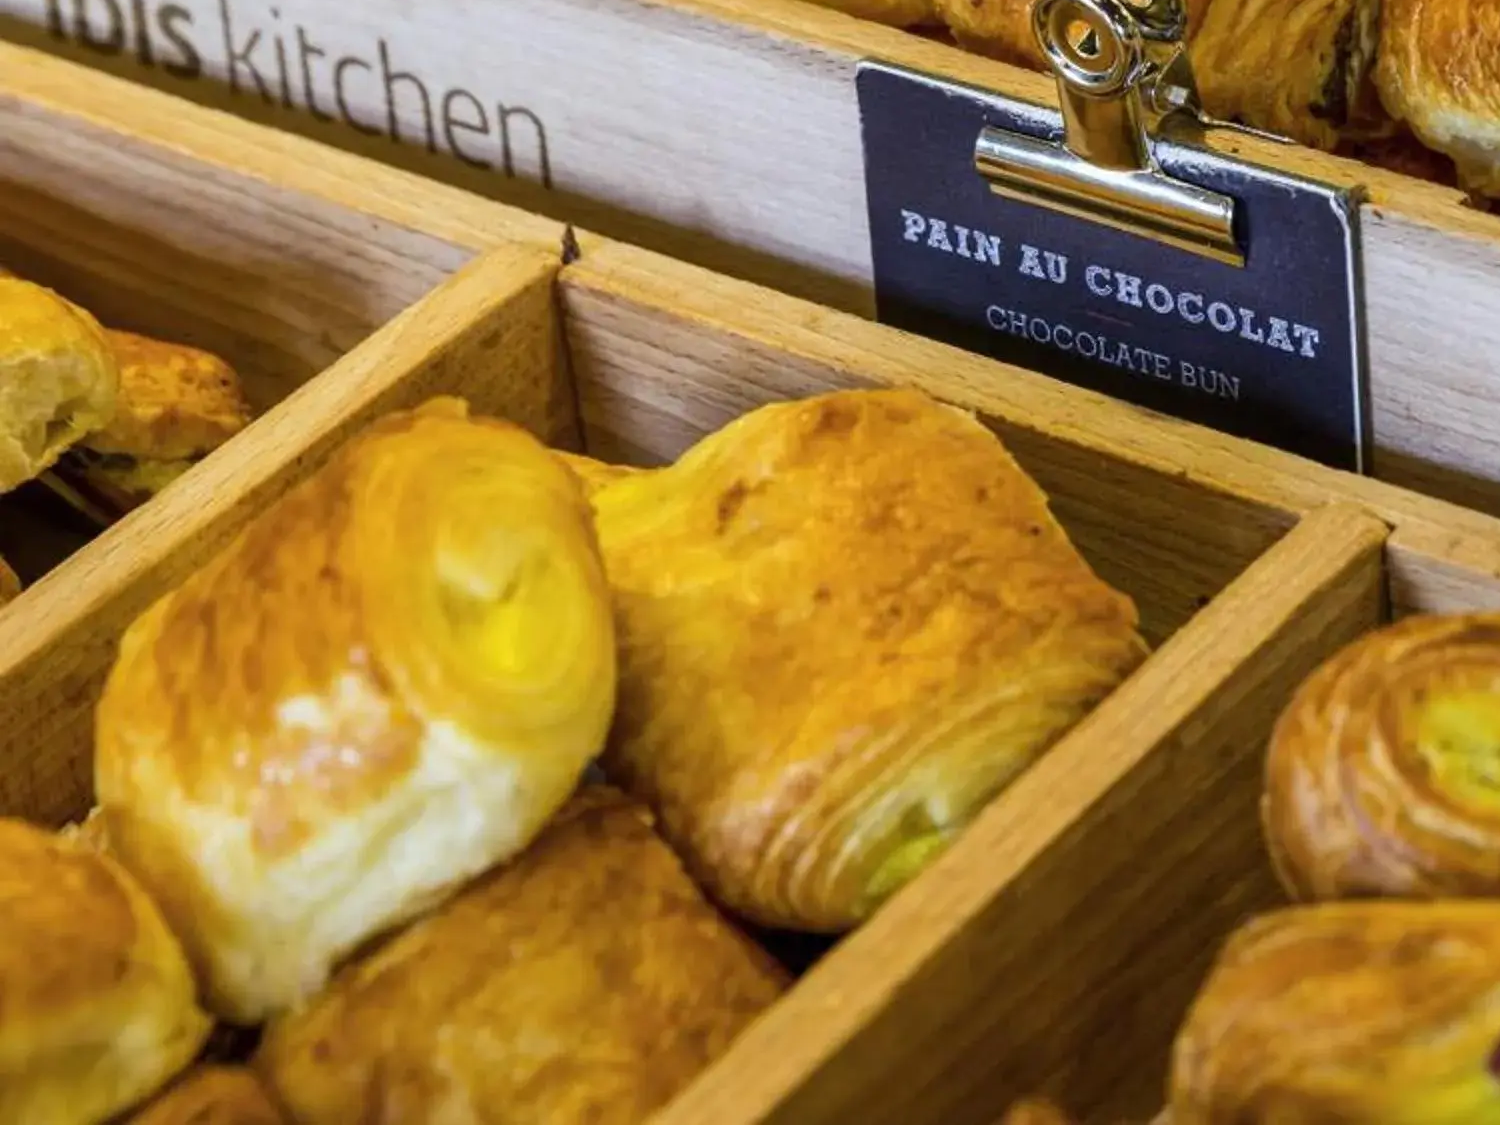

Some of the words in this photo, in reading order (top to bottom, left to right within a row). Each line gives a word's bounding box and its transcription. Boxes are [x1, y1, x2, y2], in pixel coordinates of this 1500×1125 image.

[900, 208, 1002, 266] PAIN
[1018, 243, 1068, 284] AU
[1085, 266, 1321, 358] CHOCOLAT
[986, 304, 1171, 381] CHOCOLATE
[1181, 361, 1241, 401] BUN
